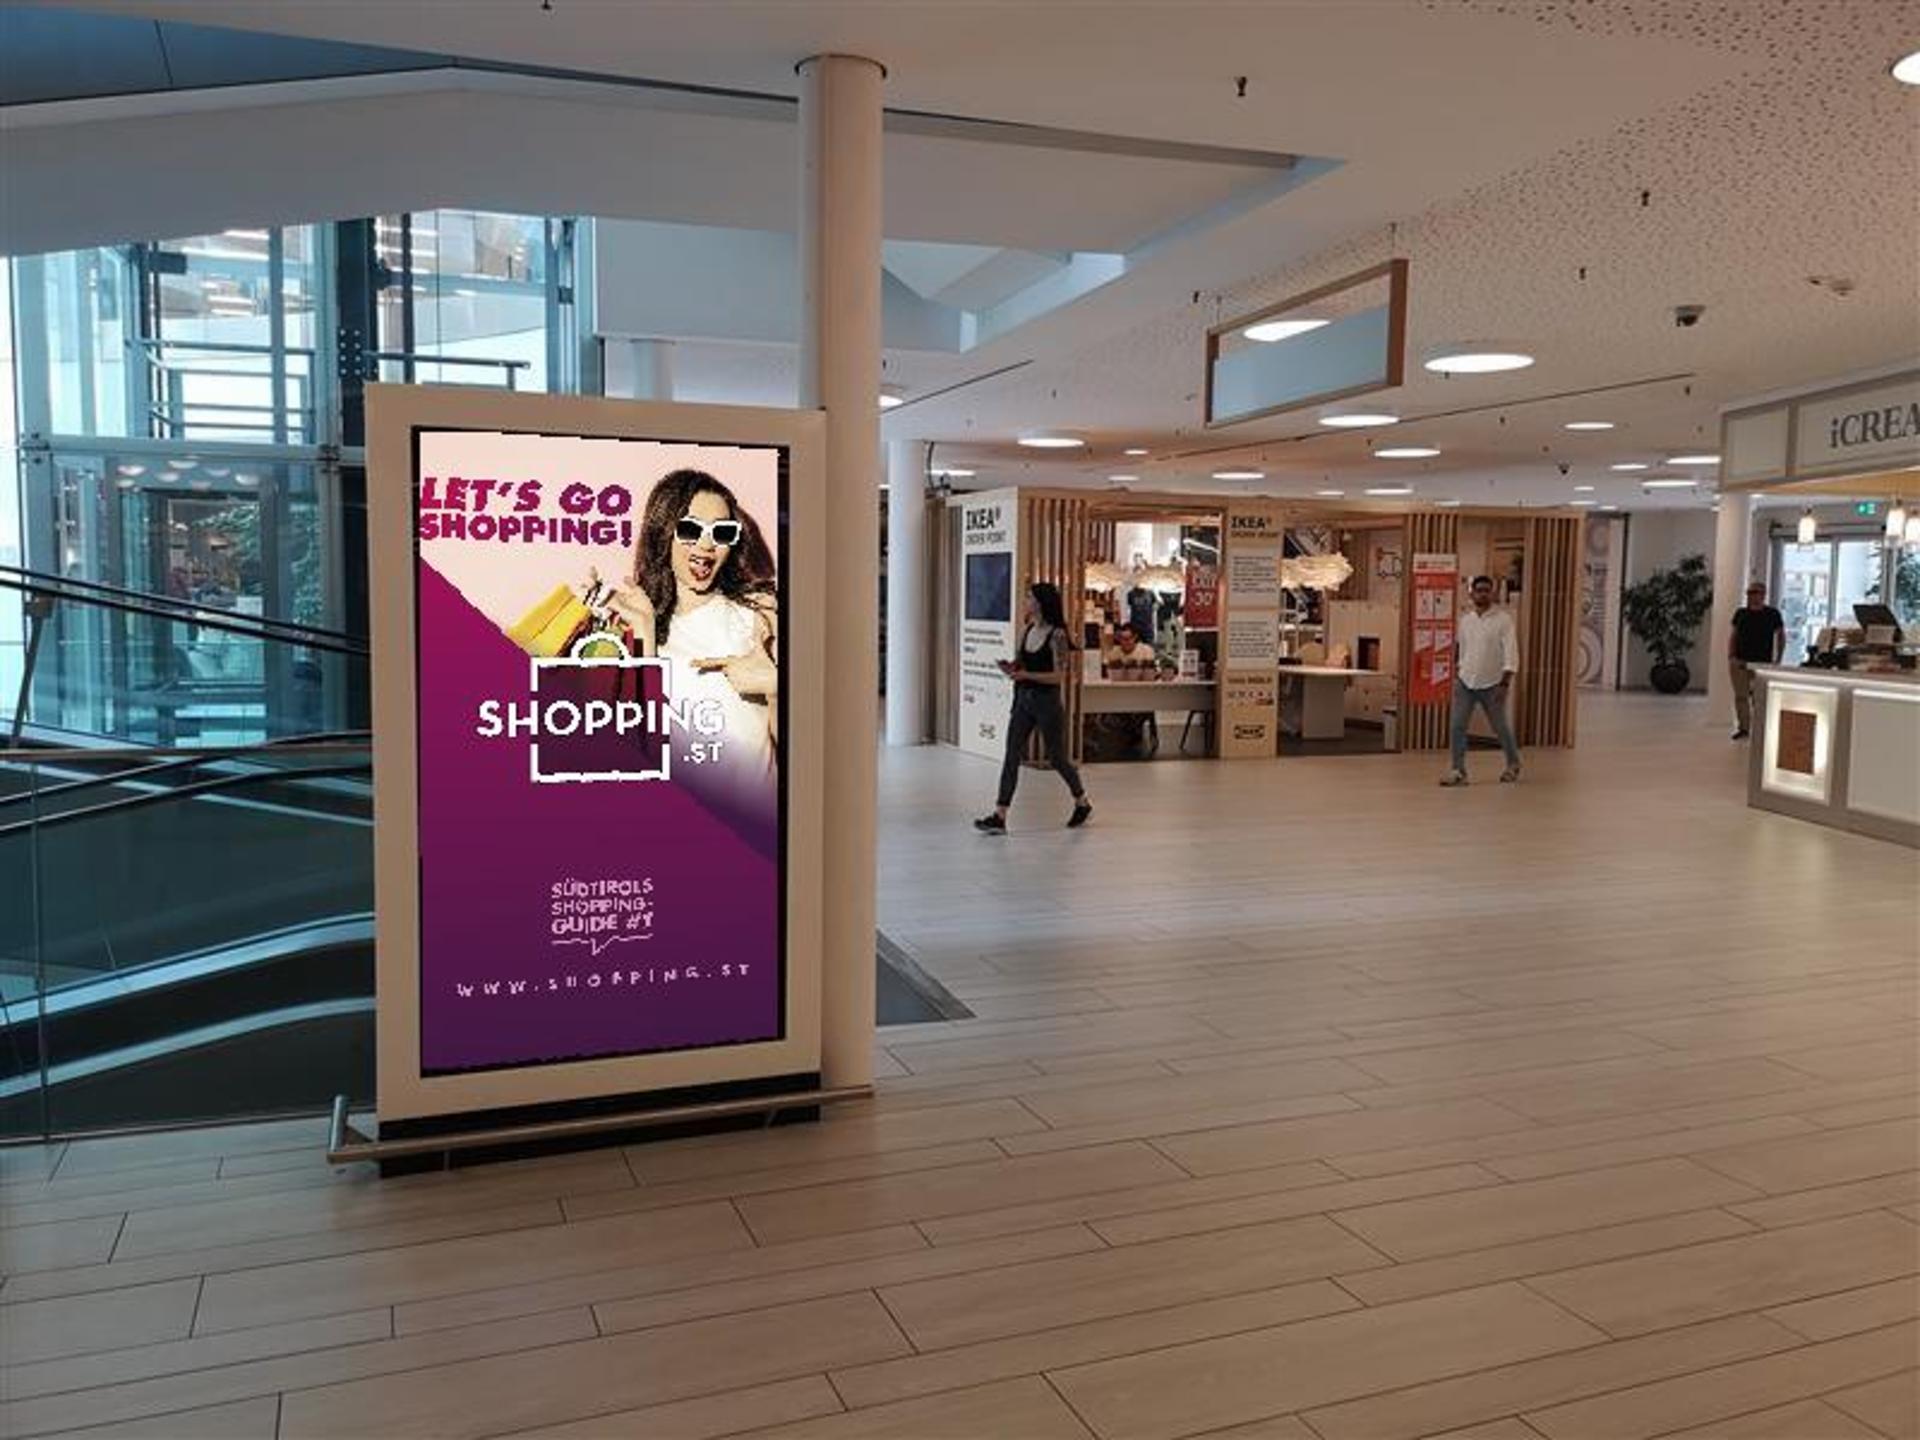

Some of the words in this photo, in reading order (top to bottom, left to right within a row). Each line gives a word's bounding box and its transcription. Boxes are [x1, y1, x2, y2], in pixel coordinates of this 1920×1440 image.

[420, 477, 542, 512] LET'S
[559, 482, 632, 516] GO
[420, 513, 632, 547] SHOPPING!
[477, 700, 724, 737] SHOPPING
[551, 914, 618, 934] GUIDE
